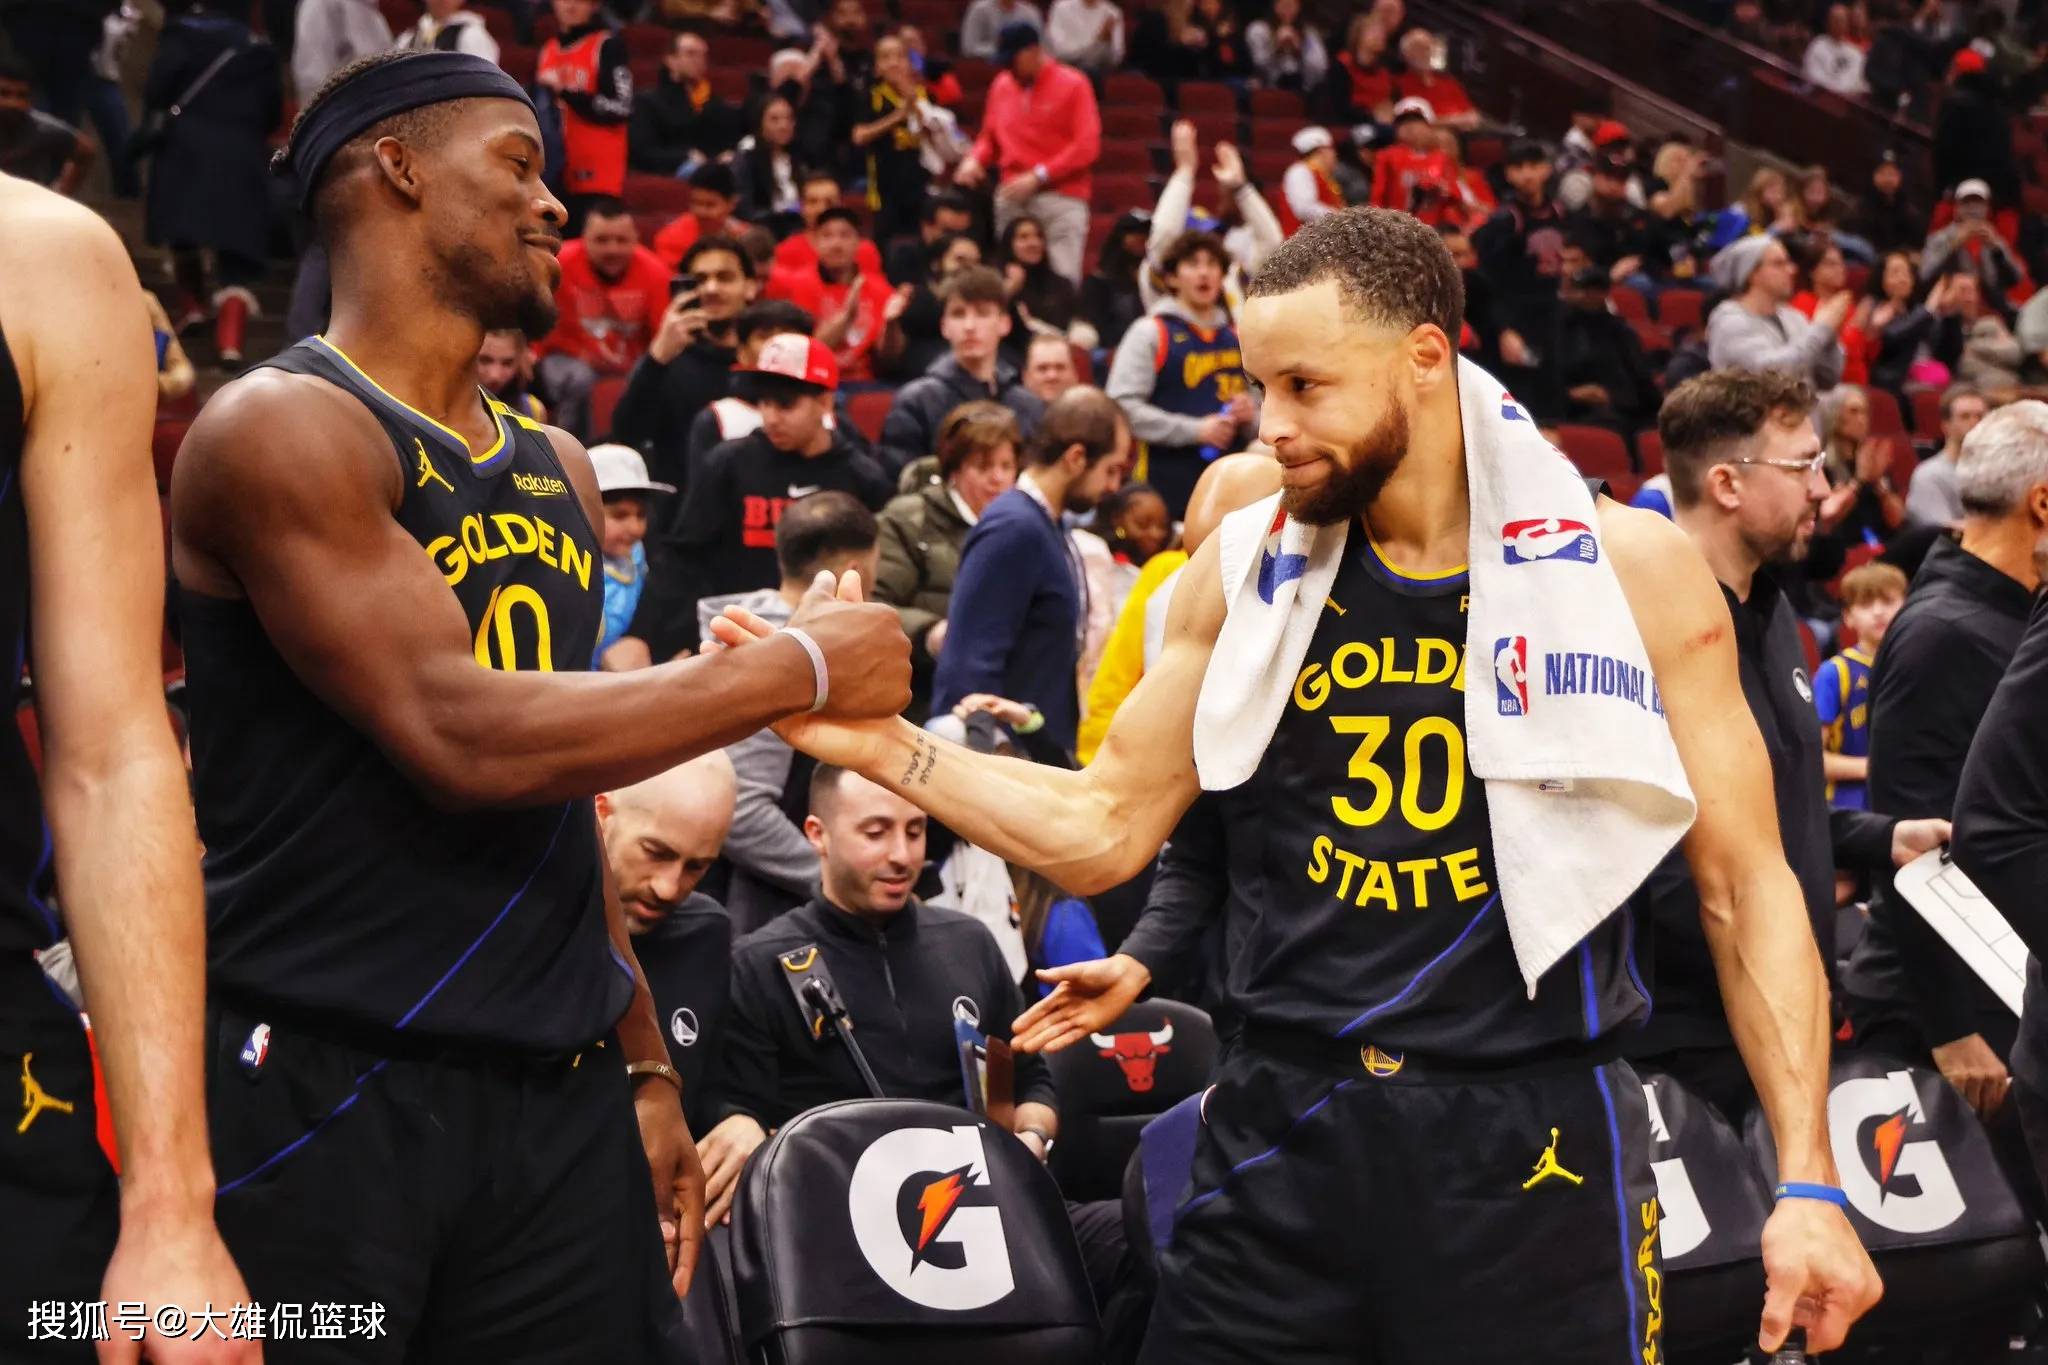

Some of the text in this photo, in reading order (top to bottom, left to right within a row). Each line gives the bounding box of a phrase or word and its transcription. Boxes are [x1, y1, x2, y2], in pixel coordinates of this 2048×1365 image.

[512, 473, 568, 496] Rakuten
[425, 512, 592, 591] GOLDEN
[1579, 538, 1595, 560] NBA
[475, 584, 554, 673] 10
[1501, 698, 1518, 712] NBA
[1545, 653, 1647, 710] NATIONAL
[1329, 716, 1465, 831] 30
[1307, 835, 1488, 911] STATE
[848, 1125, 1015, 1311] G
